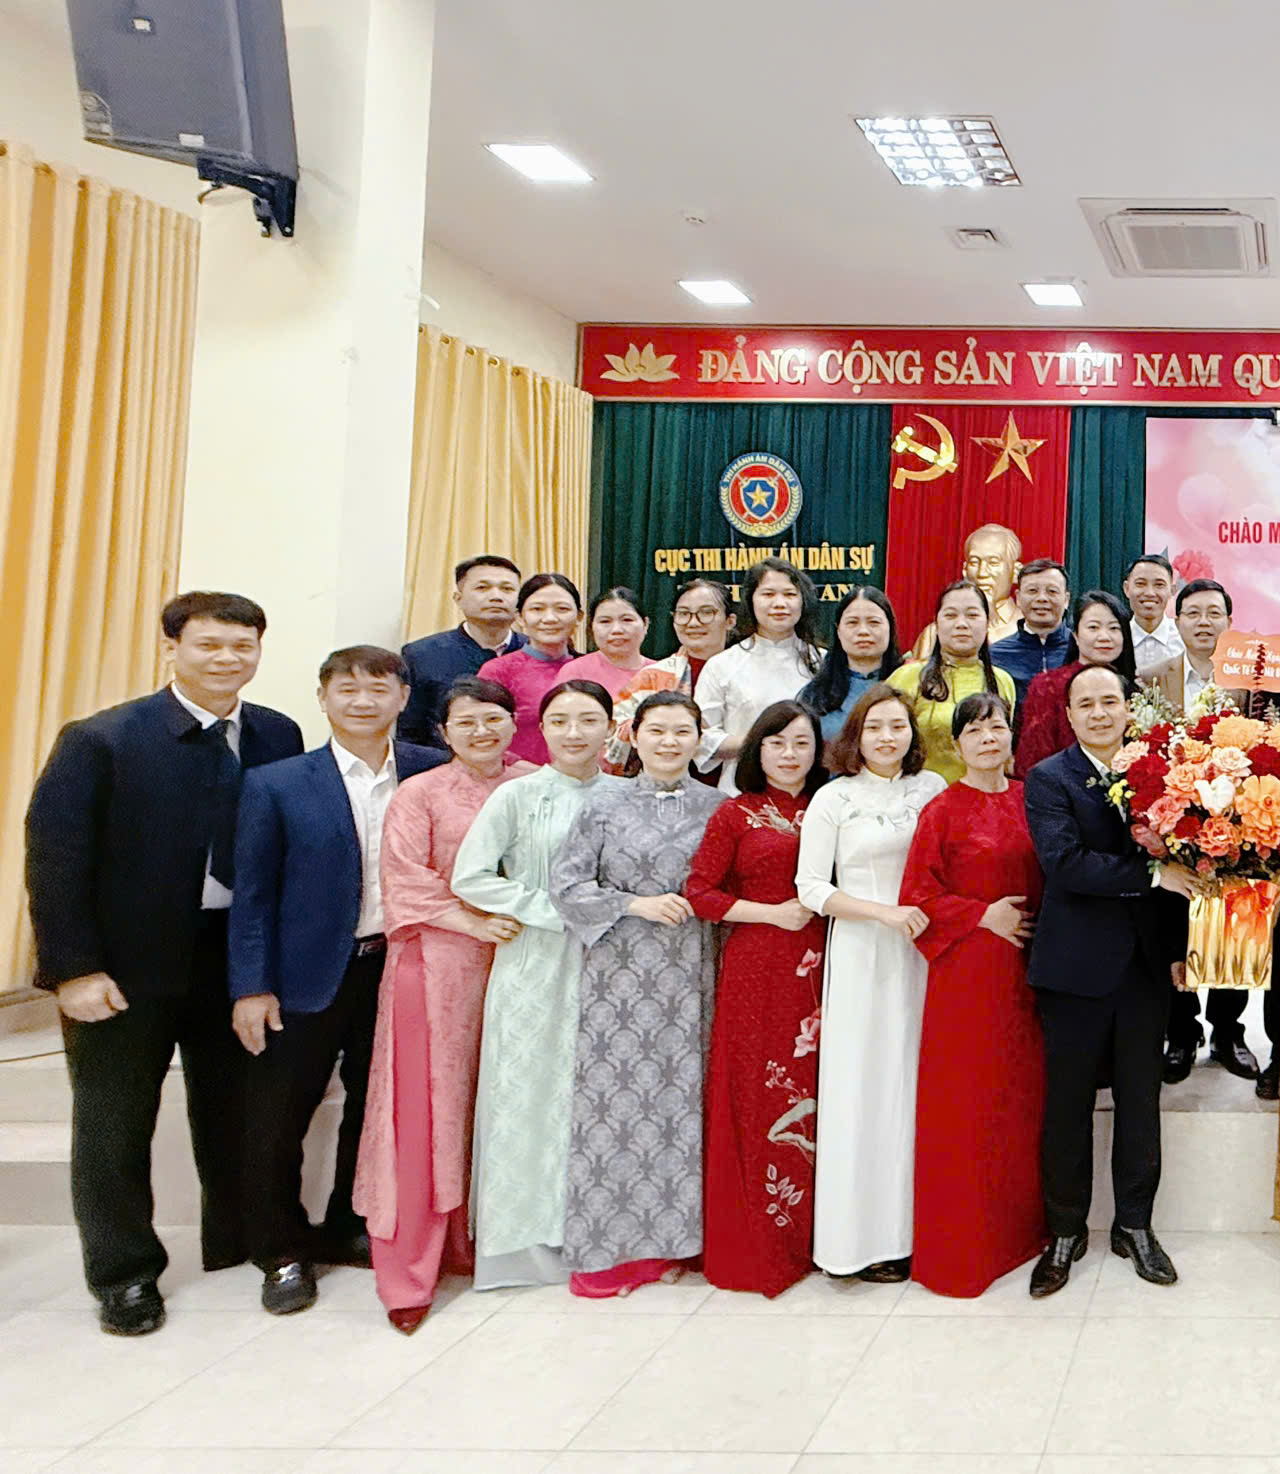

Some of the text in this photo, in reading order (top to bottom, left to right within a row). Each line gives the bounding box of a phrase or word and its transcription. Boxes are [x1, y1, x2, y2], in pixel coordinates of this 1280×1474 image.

[697, 335, 808, 384] ĐẢNG
[818, 340, 924, 393] CỘNG
[934, 337, 1015, 385] SẢN
[1027, 342, 1122, 395] VIỆT
[1132, 353, 1223, 387] NAM
[1218, 517, 1262, 544] CHÀO
[654, 548, 690, 576] CỤC
[693, 548, 721, 571] THI
[780, 542, 805, 570] ÁN
[808, 542, 845, 571] DÂN
[849, 544, 875, 575] SỰ
